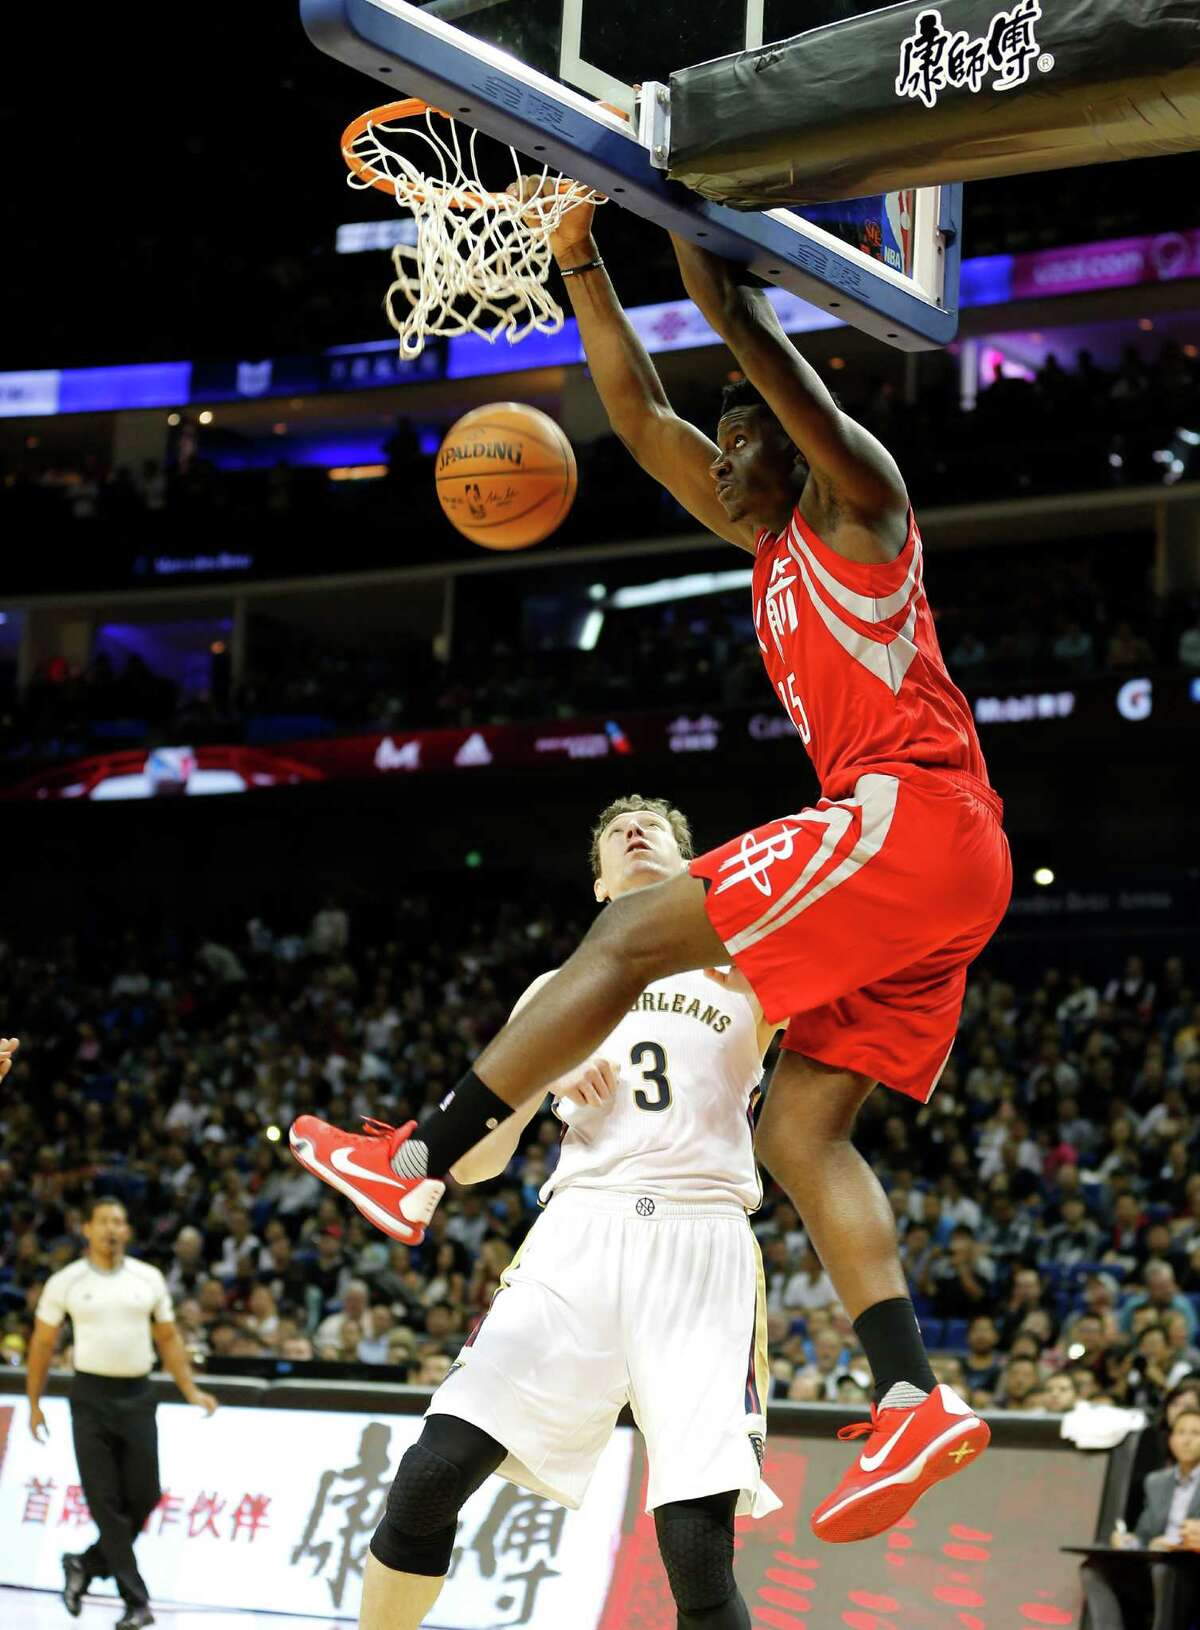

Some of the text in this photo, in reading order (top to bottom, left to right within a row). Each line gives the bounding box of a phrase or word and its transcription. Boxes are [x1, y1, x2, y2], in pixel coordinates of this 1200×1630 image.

[897, 0, 1039, 107] 康師傅
[884, 245, 901, 271] NBA
[440, 441, 524, 471] SPALDING
[778, 672, 811, 745] 15
[630, 991, 732, 1034] RLEANS
[629, 1040, 672, 1112] 3
